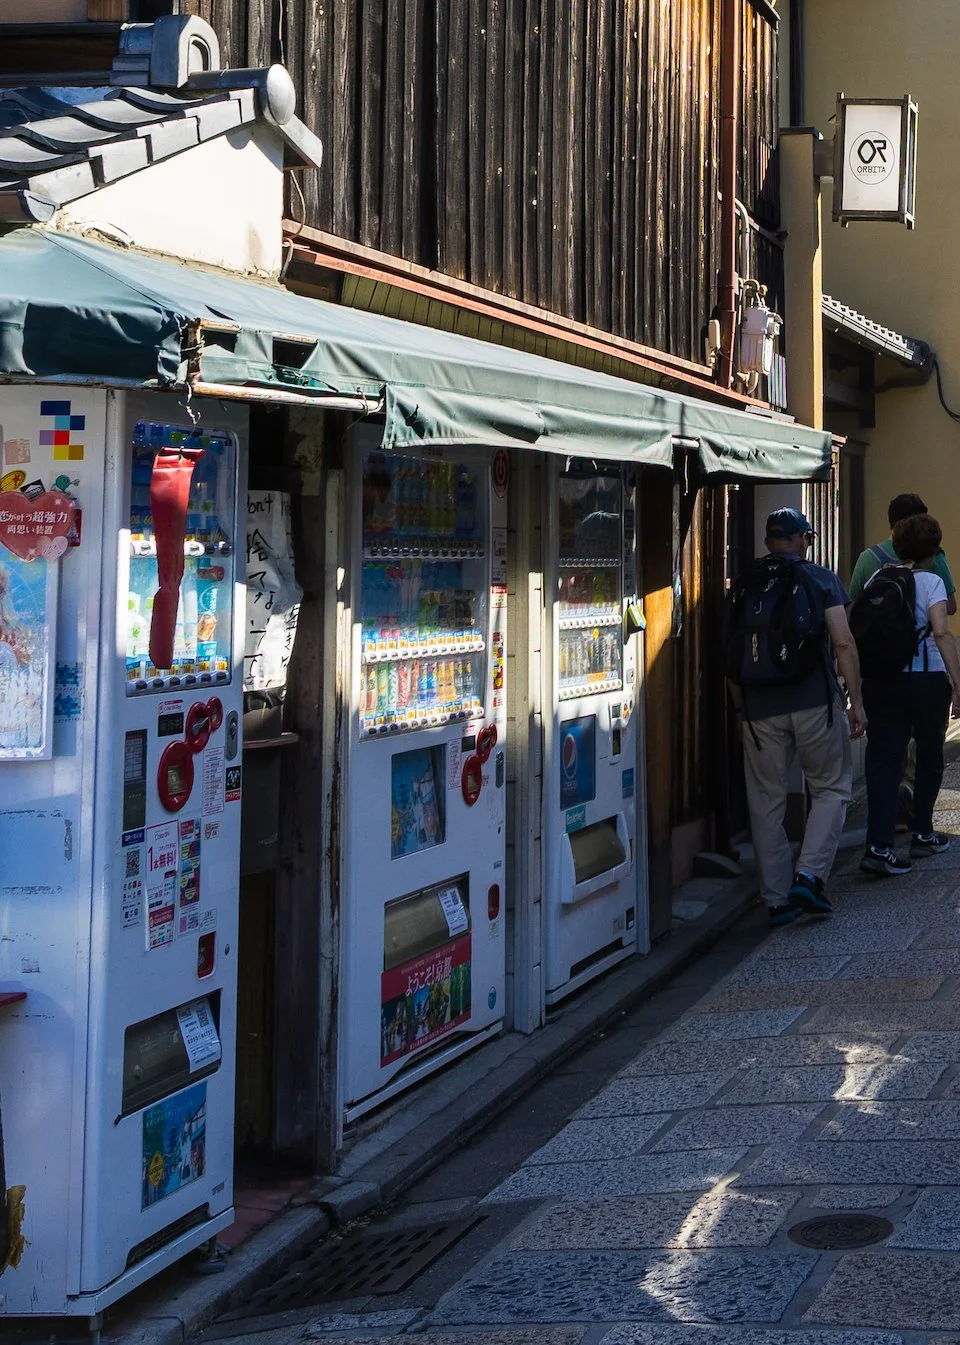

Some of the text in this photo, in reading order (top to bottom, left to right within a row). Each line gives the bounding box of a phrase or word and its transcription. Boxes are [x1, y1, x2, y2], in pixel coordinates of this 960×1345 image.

[857, 166, 887, 174] ORBITA
[7, 524, 55, 536] 両思い装置
